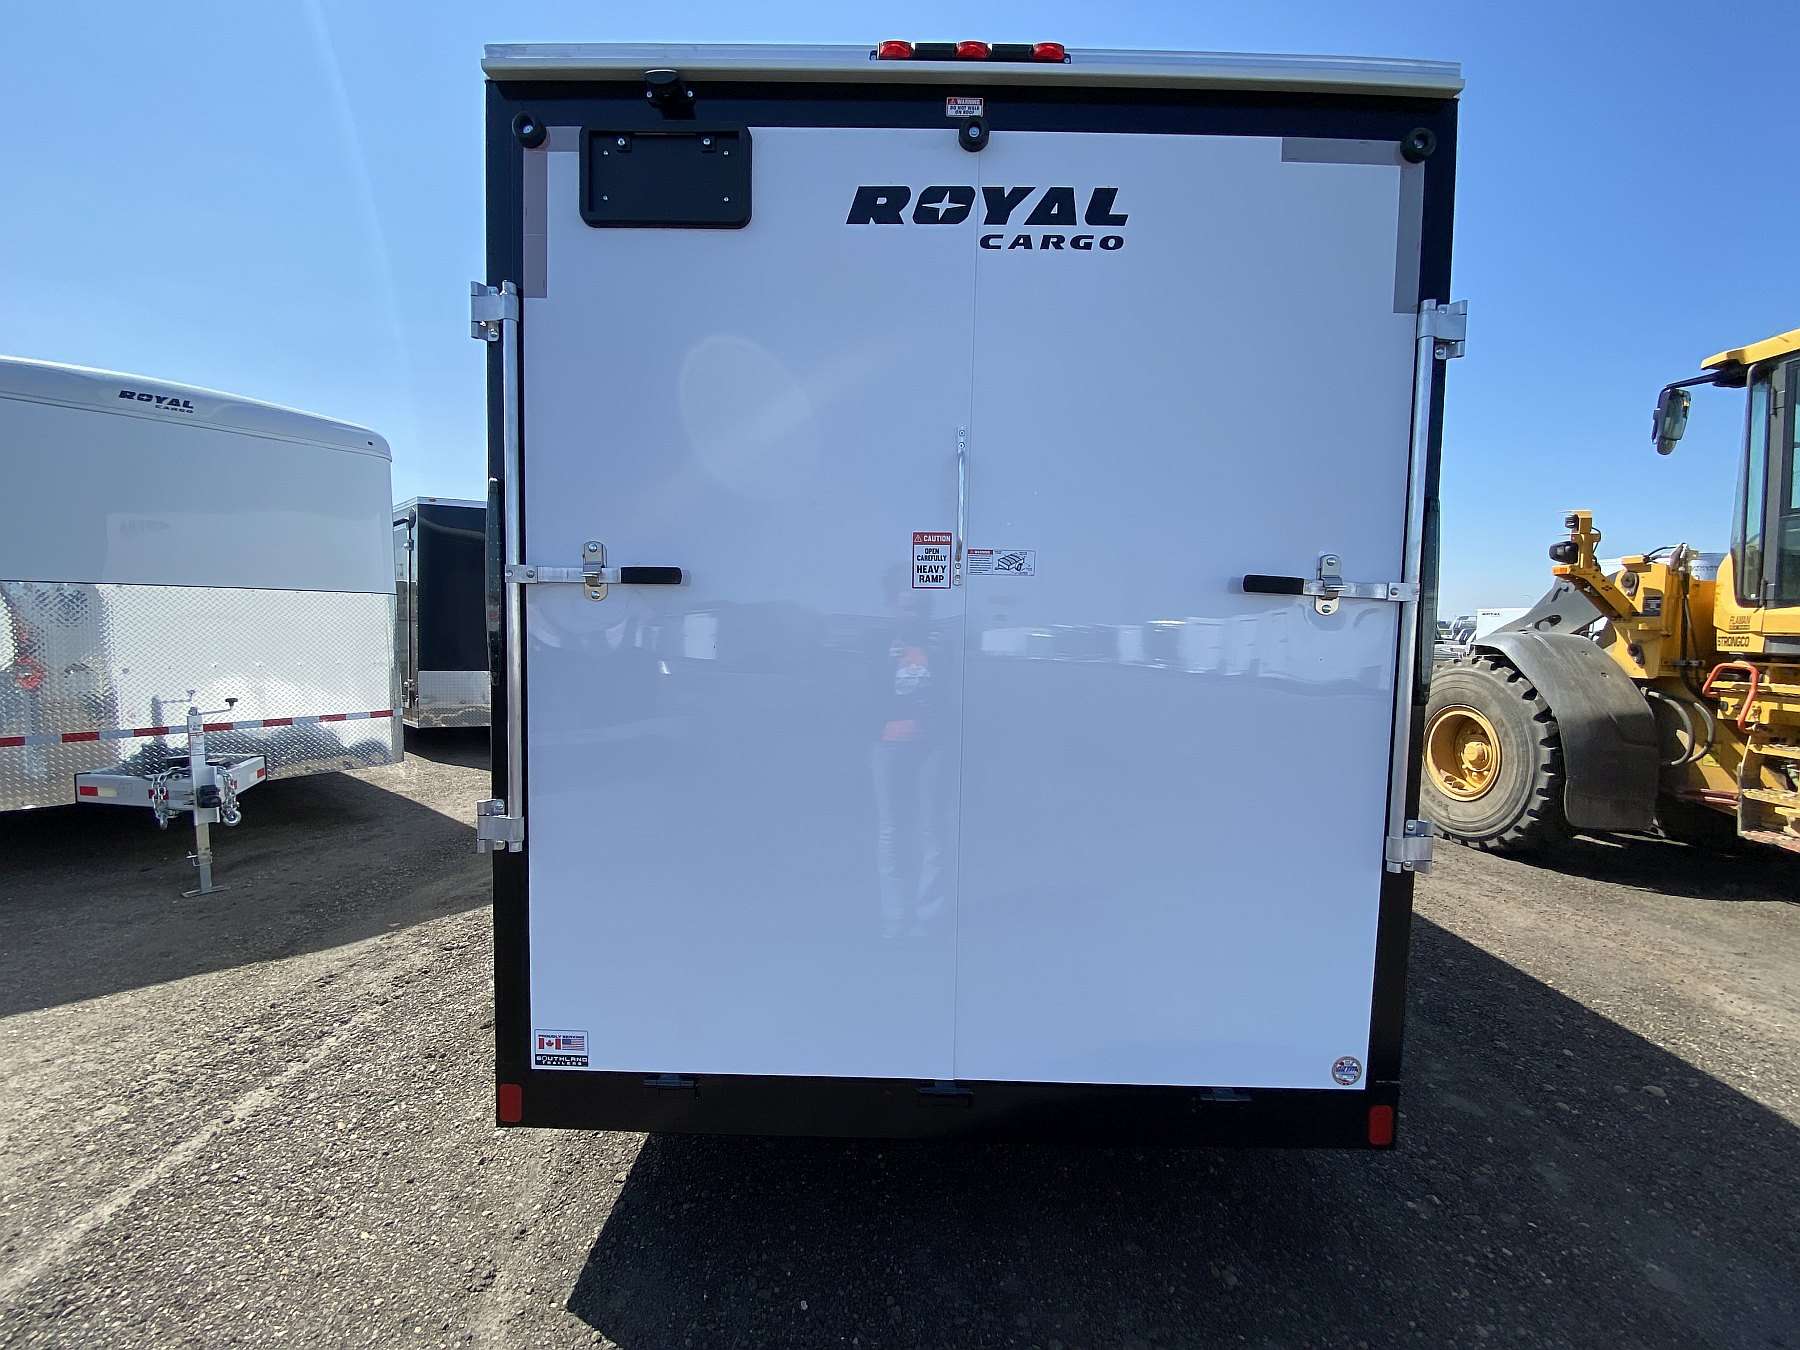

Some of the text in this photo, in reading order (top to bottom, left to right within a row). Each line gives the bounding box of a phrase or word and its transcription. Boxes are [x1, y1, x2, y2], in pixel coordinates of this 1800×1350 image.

[846, 185, 1129, 227] ROYAL
[979, 234, 1125, 251] CARGO
[119, 390, 194, 409] ROYAL
[155, 404, 194, 414] CARGO
[916, 565, 946, 574] HEAVY
[919, 575, 944, 583] RAMP
[1718, 636, 1750, 647] STRONGCO
